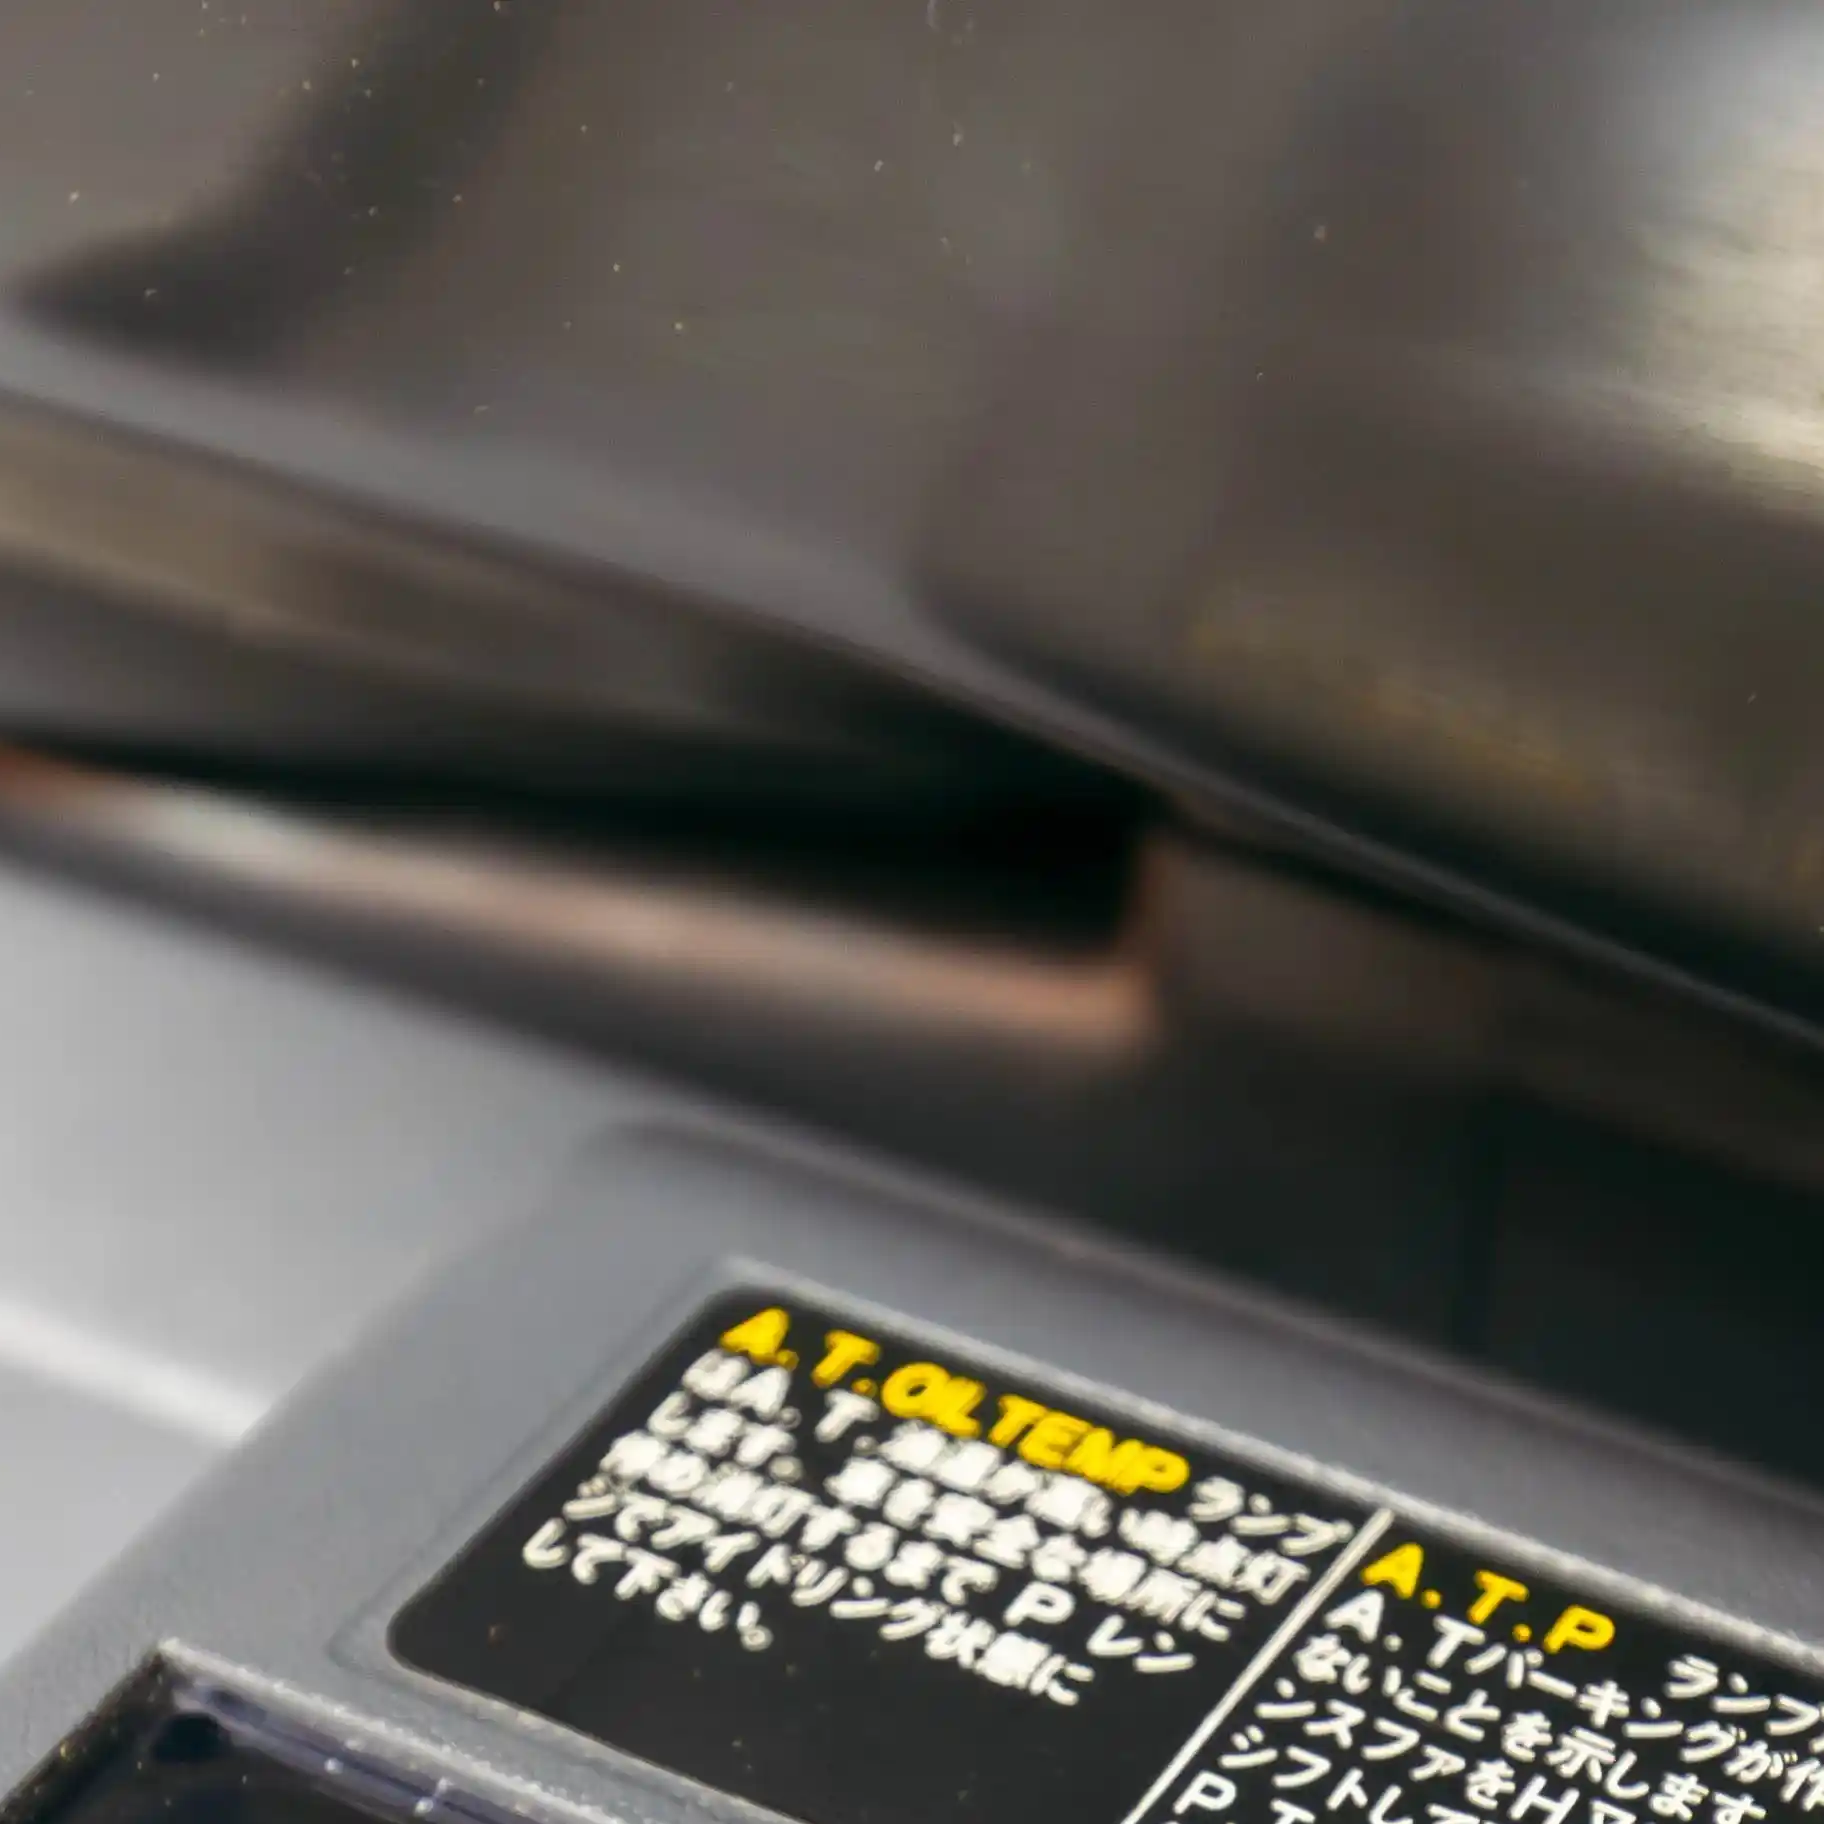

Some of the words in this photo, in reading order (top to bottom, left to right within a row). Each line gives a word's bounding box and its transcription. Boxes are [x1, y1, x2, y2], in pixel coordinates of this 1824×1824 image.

[988, 1395, 1190, 1496] TEMP
[1191, 1478, 1352, 1555] ランプ
[524, 1520, 768, 1648] して下さい。
